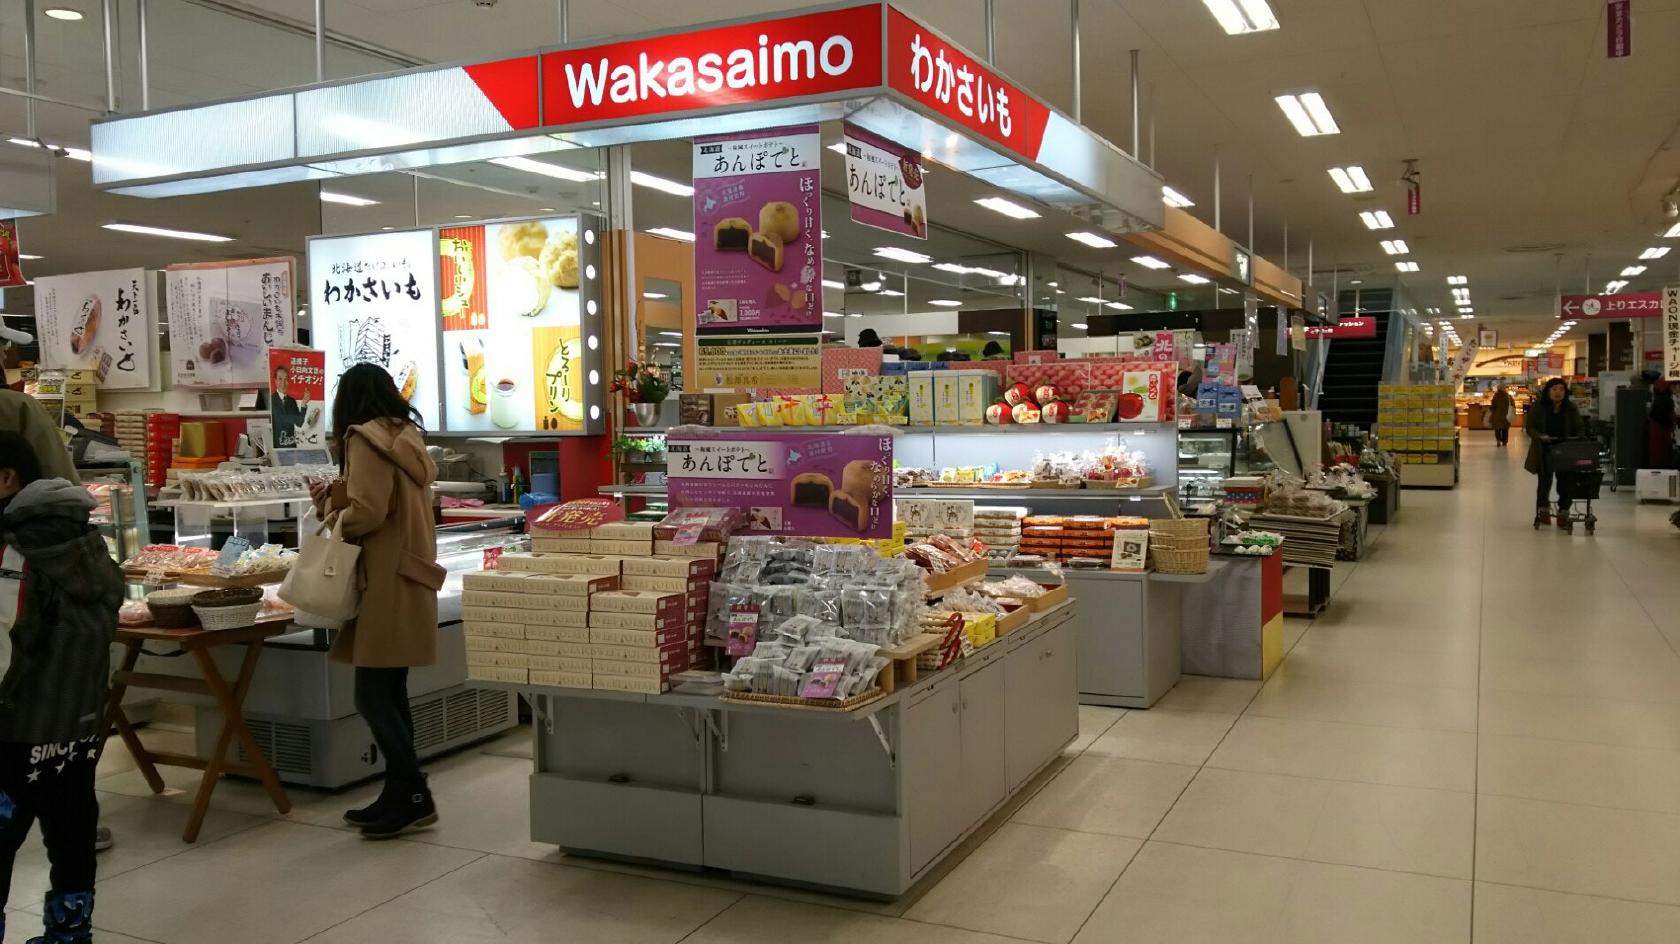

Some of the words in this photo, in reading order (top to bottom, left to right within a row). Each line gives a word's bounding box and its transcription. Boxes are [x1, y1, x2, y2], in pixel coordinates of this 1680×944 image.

[564, 34, 853, 109] Wakasaimo
[911, 33, 1012, 137] わかさいも
[714, 147, 800, 173] あんぽてと
[849, 163, 906, 206] あんぽてと
[324, 272, 421, 304] わかさいも
[116, 287, 136, 371] わかさいも
[545, 370, 562, 413] プリン
[559, 338, 570, 402] とろーり
[682, 452, 768, 473] あんぽてと
